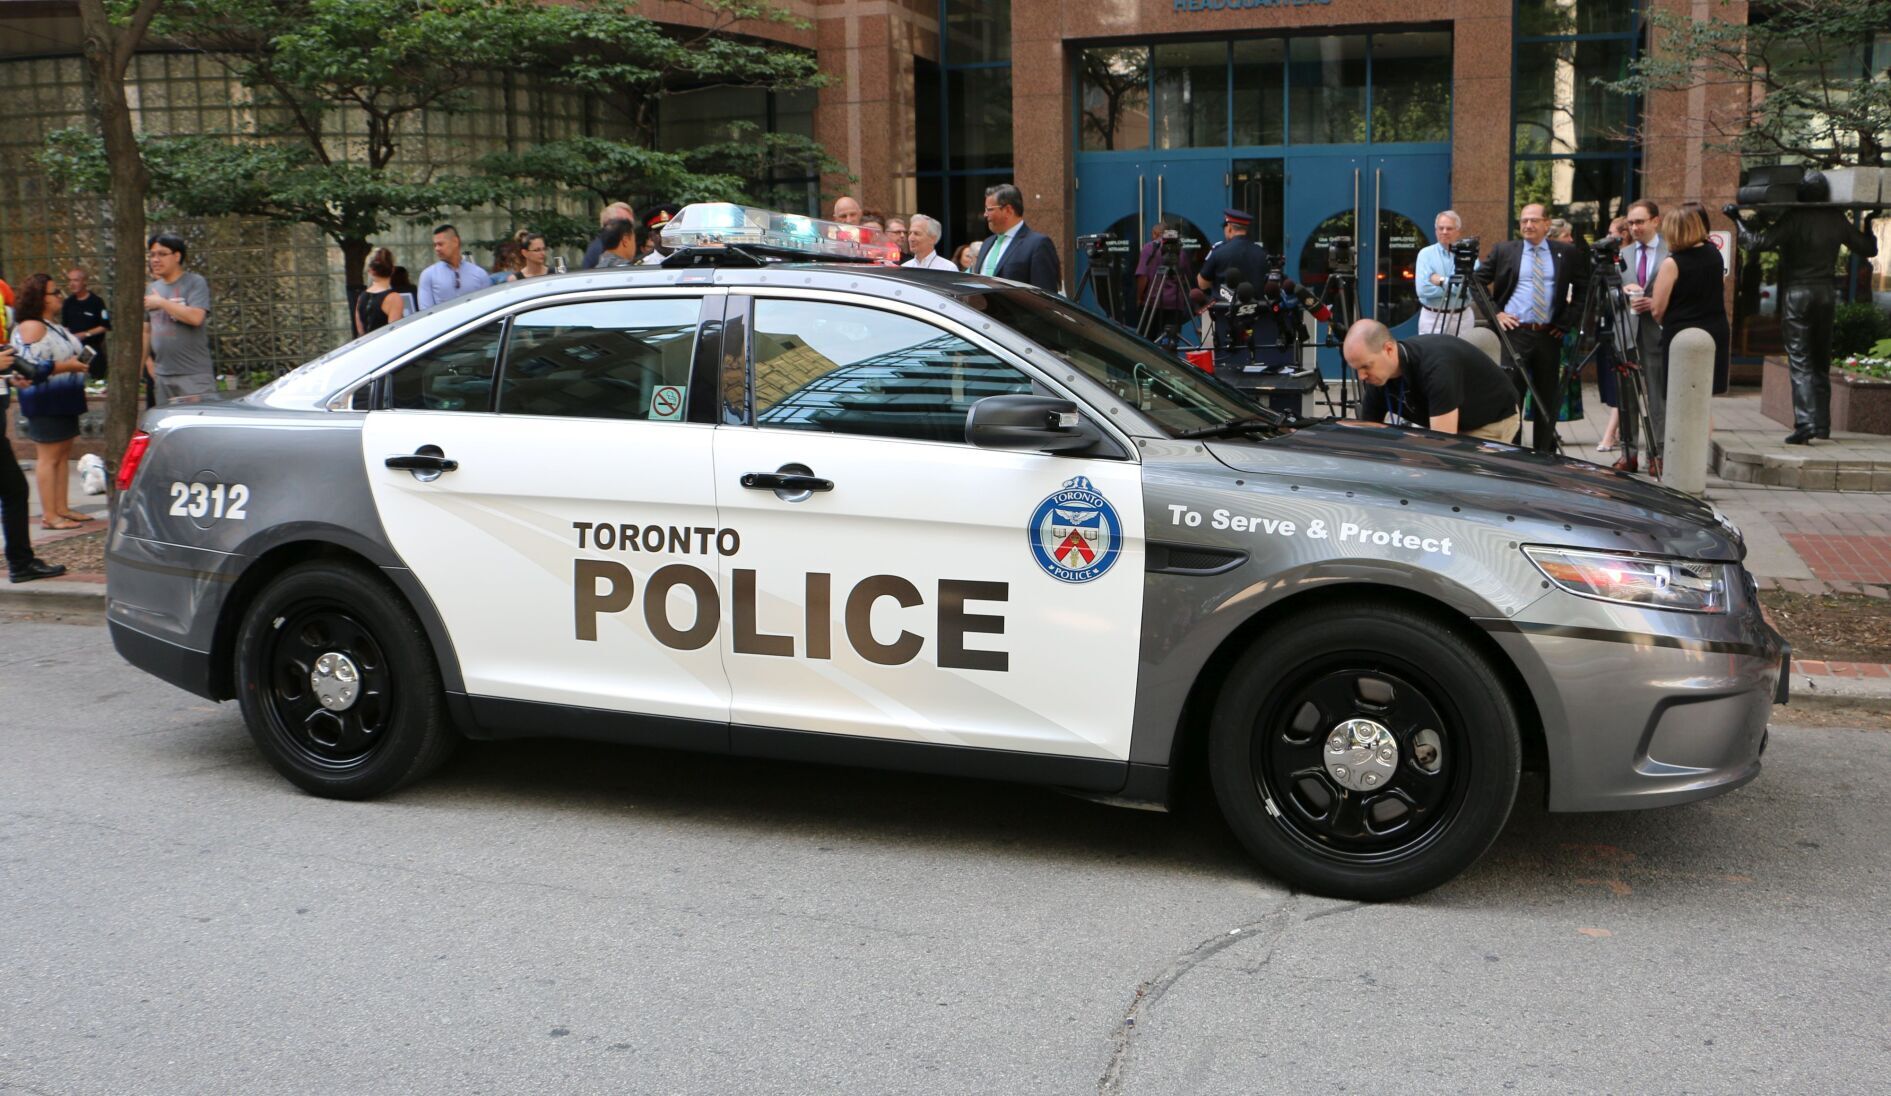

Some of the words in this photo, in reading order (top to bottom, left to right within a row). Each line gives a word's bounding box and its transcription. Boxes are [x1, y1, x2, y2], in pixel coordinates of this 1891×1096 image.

[169, 482, 250, 520] 2312
[1052, 491, 1104, 508] TORONTO
[573, 521, 741, 557] TORONTO
[1168, 504, 1202, 527] To
[1211, 509, 1296, 537] Serve
[1306, 519, 1329, 540] &
[1339, 522, 1453, 556] Protect
[1054, 568, 1093, 580] POLICE
[574, 558, 1010, 673] POLICE
